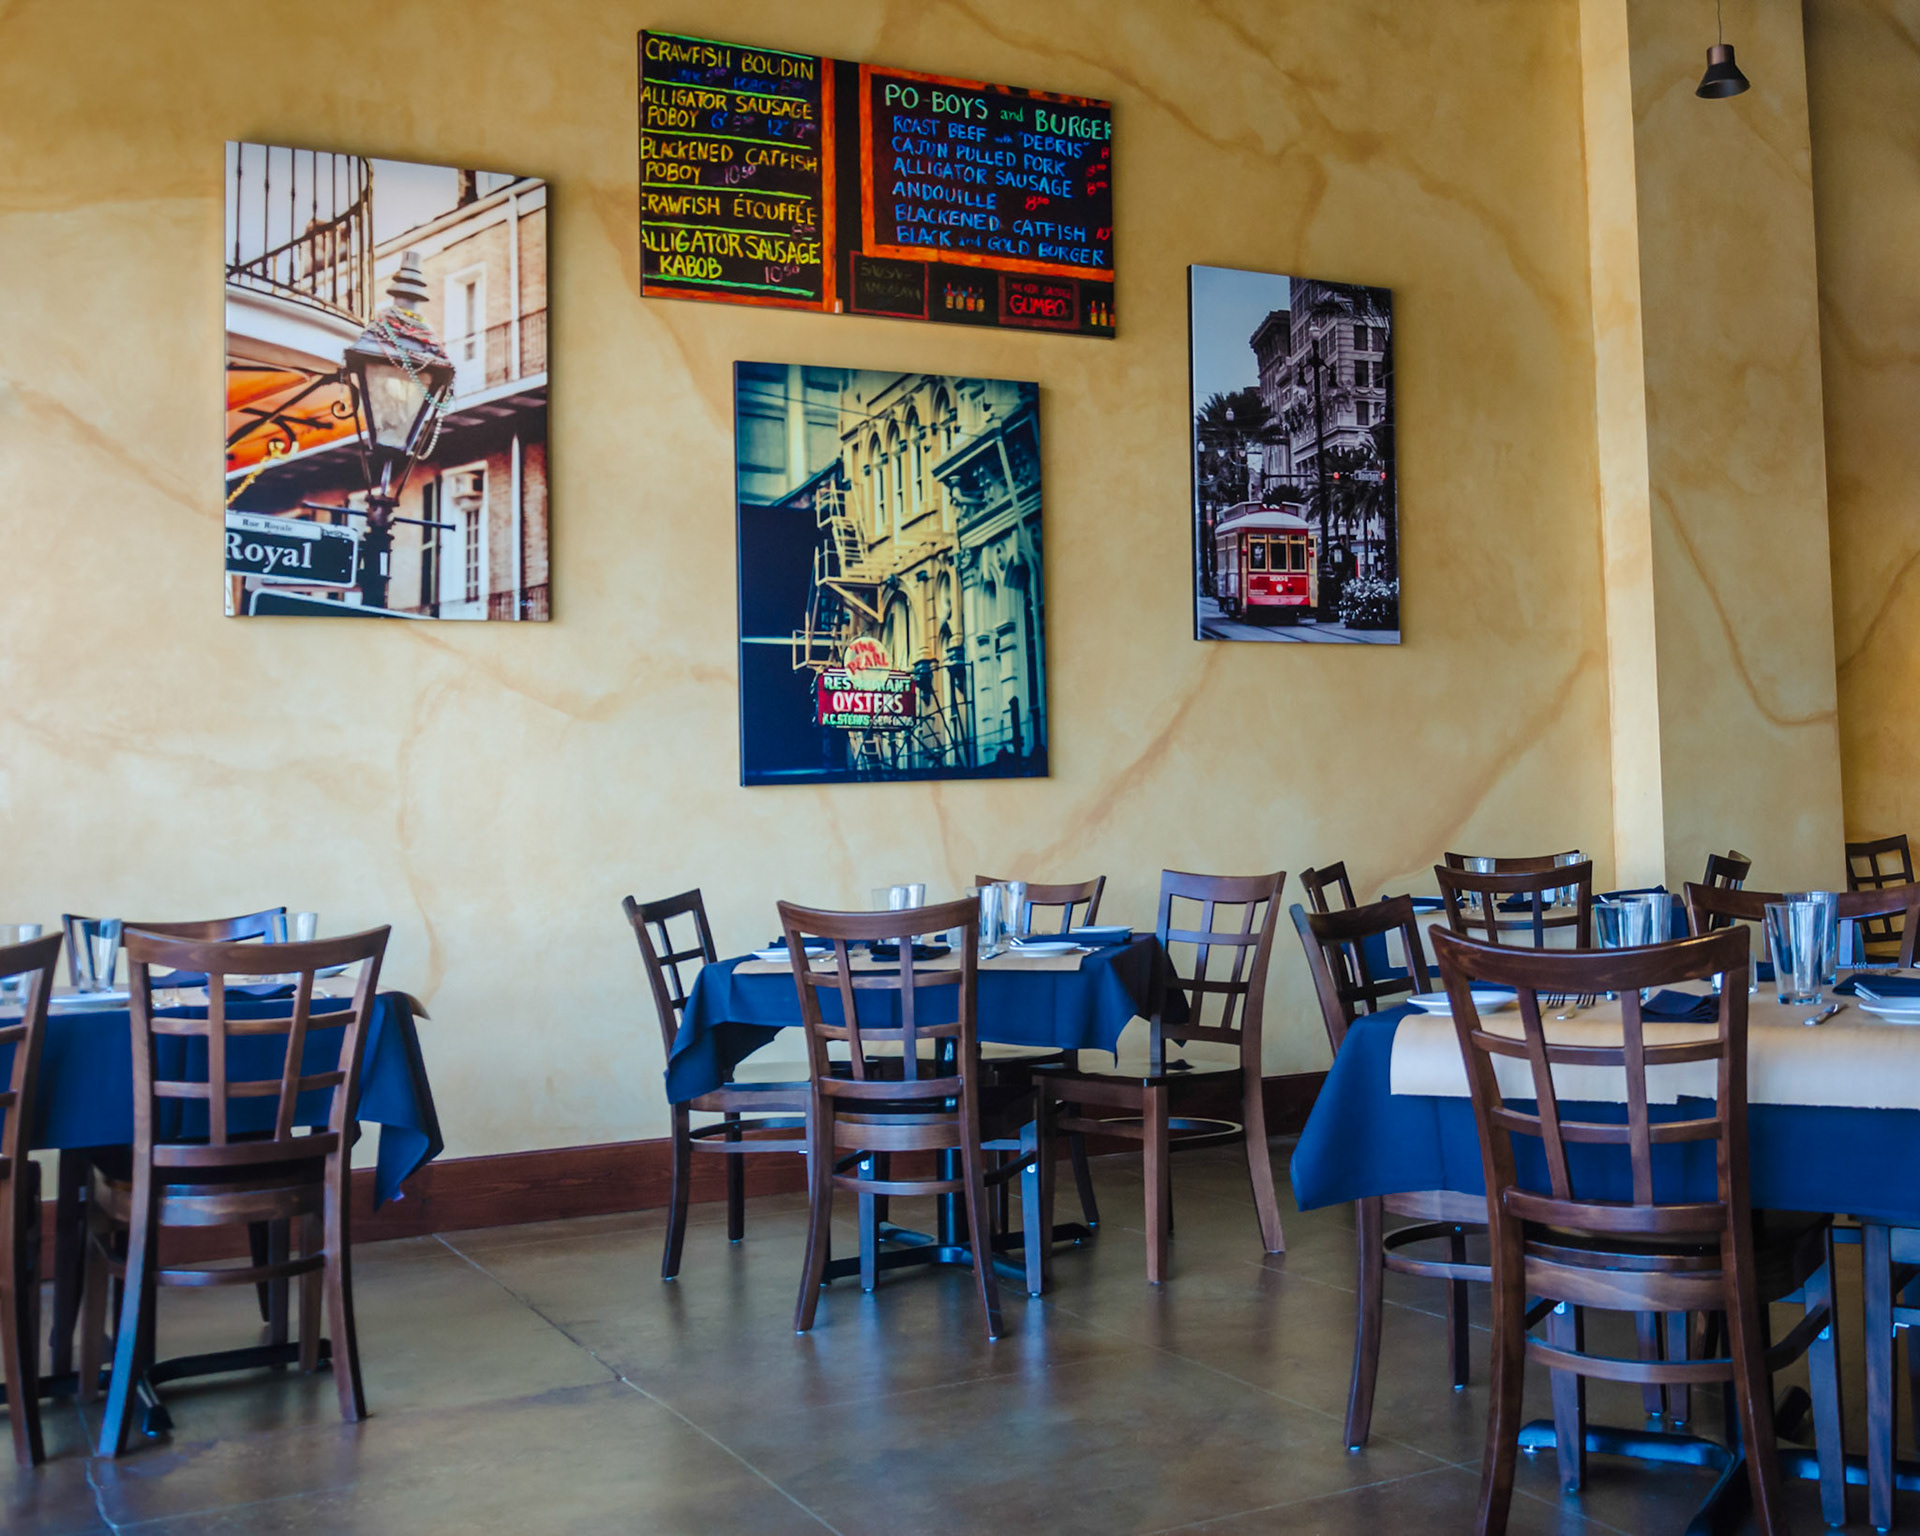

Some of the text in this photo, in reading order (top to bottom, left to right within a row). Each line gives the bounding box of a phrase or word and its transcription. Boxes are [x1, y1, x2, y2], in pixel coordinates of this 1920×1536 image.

[645, 38, 814, 81] CRAWFISH BOUDIN
[641, 86, 813, 119] ALLIGATOR SAUSAGE
[647, 105, 699, 129] POBOY
[1000, 107, 1024, 123] and
[893, 115, 940, 137] ROAST
[947, 122, 987, 142] BEEF
[641, 137, 817, 173] BLACKENED CATFISH
[891, 136, 948, 158] CAJUN
[956, 144, 1017, 167] PULLED
[1023, 152, 1067, 176] PORK
[645, 162, 701, 185] POBOY
[893, 157, 988, 186] ALLIGATOR
[995, 170, 1073, 199] SAUSAGE
[892, 181, 997, 210] ANDOUILLE
[895, 203, 1000, 231] BLACKENED
[1013, 219, 1086, 243] CATFISH
[746, 235, 821, 265] SAUSAGE
[896, 226, 951, 247] BLACK
[987, 236, 1030, 255] GOLD
[1038, 243, 1105, 266] BURGER
[660, 255, 722, 279] KABOB
[1009, 294, 1067, 317] GUMBO
[226, 532, 312, 574] Royal
[833, 692, 904, 714] OYSTERS
